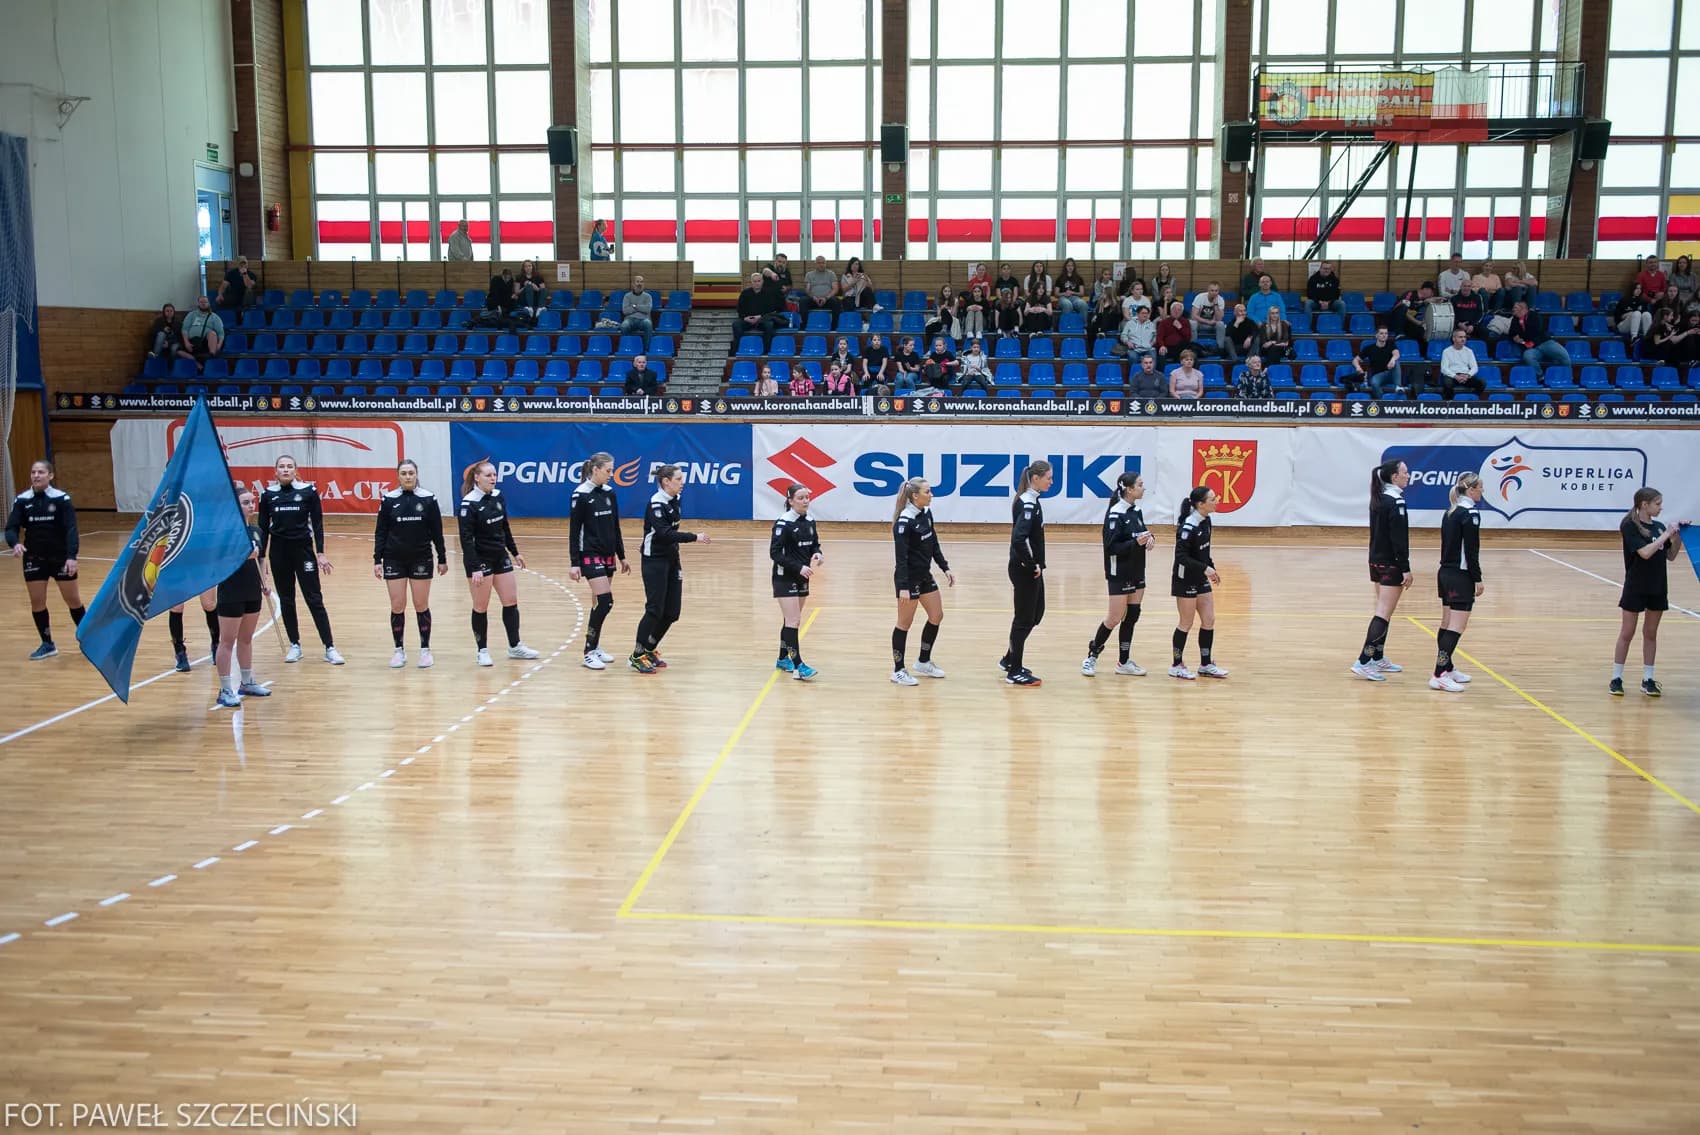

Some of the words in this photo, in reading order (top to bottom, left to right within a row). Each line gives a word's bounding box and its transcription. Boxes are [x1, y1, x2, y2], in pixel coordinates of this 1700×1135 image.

[119, 395, 253, 409] www.koronahdball.pl
[320, 397, 457, 412] www.koronahandball.pl
[523, 398, 663, 413] www.koronahandball.pl
[730, 398, 862, 410] www.koronahandball.
[943, 399, 1090, 414] www.koronahandball.pl
[1161, 401, 1311, 414] www.koronahandball.pl
[1383, 402, 1537, 417] www.koronahandball.pl
[1408, 470, 1473, 486] PGNi
[1542, 466, 1634, 480] SUPERLIGA
[1560, 482, 1615, 492] KOBIET
